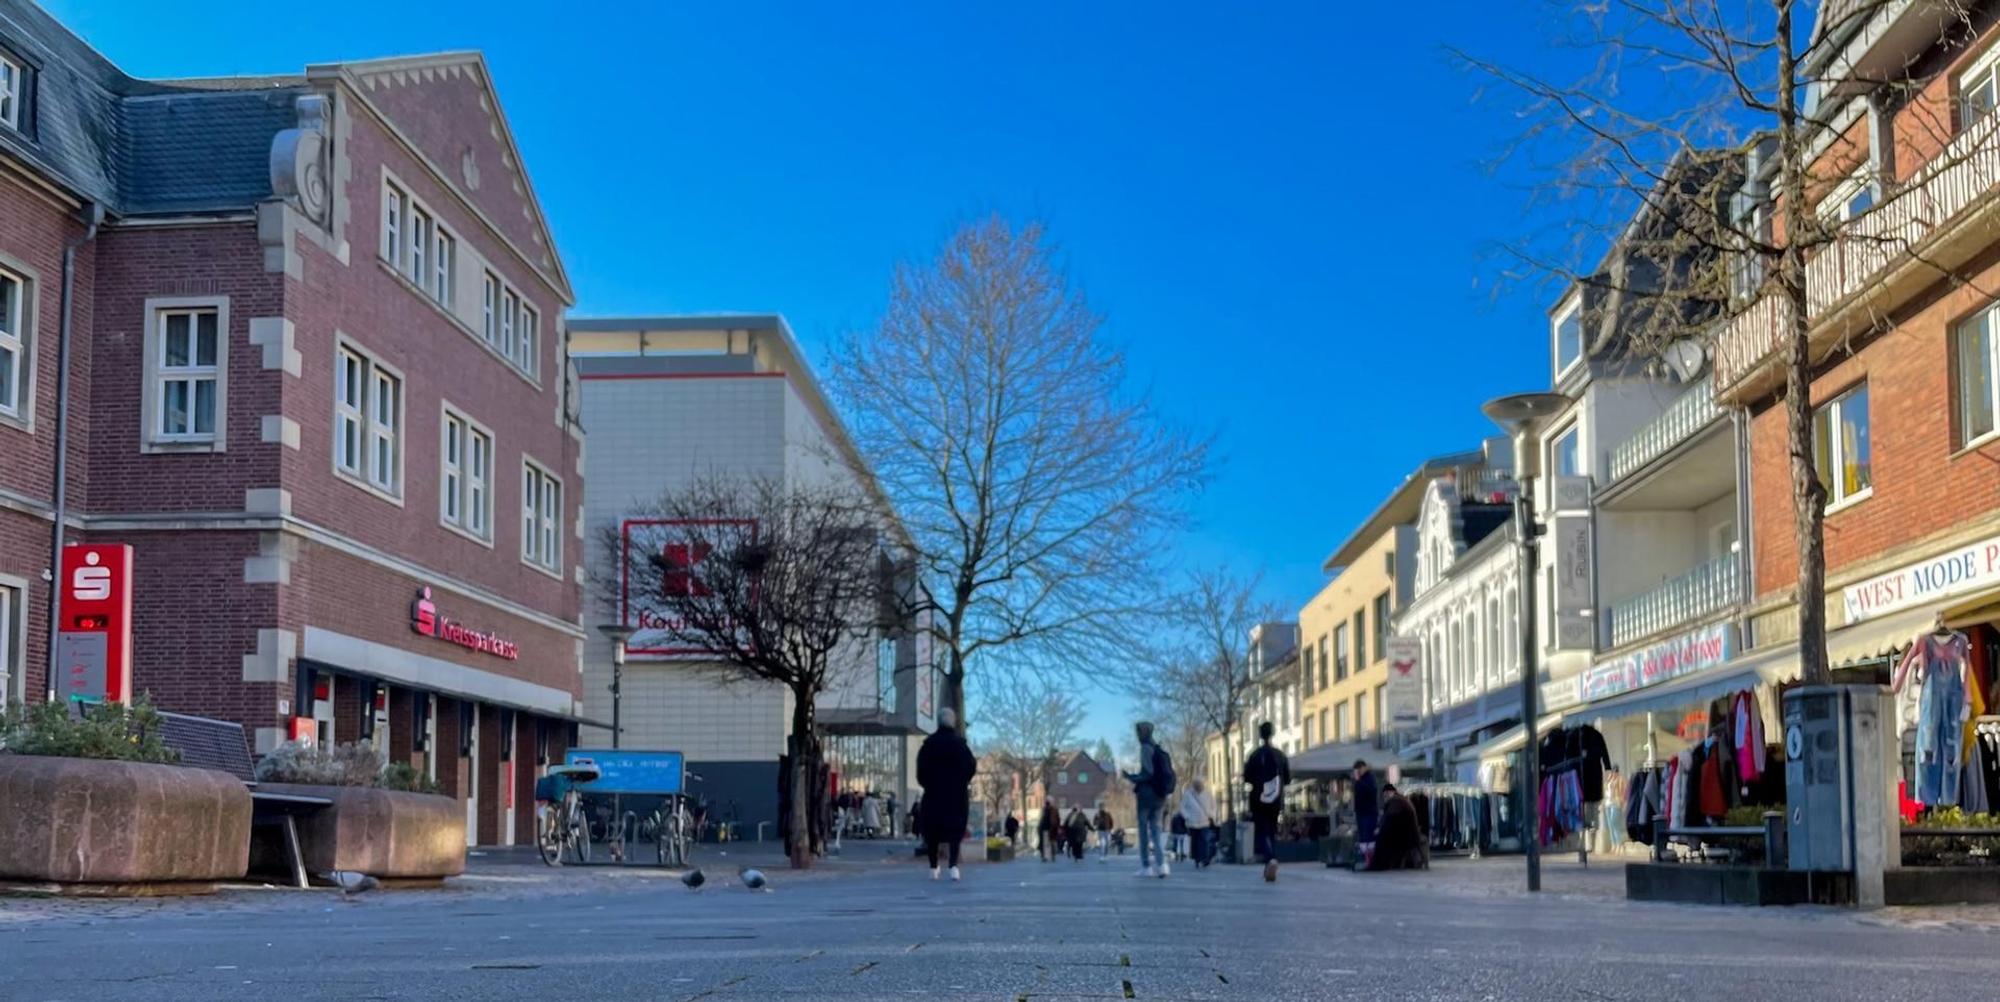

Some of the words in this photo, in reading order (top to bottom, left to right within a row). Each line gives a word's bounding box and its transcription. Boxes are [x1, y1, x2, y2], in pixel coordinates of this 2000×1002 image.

[1856, 574, 1905, 612] WEST
[1912, 551, 1977, 597] MODE
[1986, 544, 2000, 575] P
[440, 615, 519, 660] Kreissparkasse
